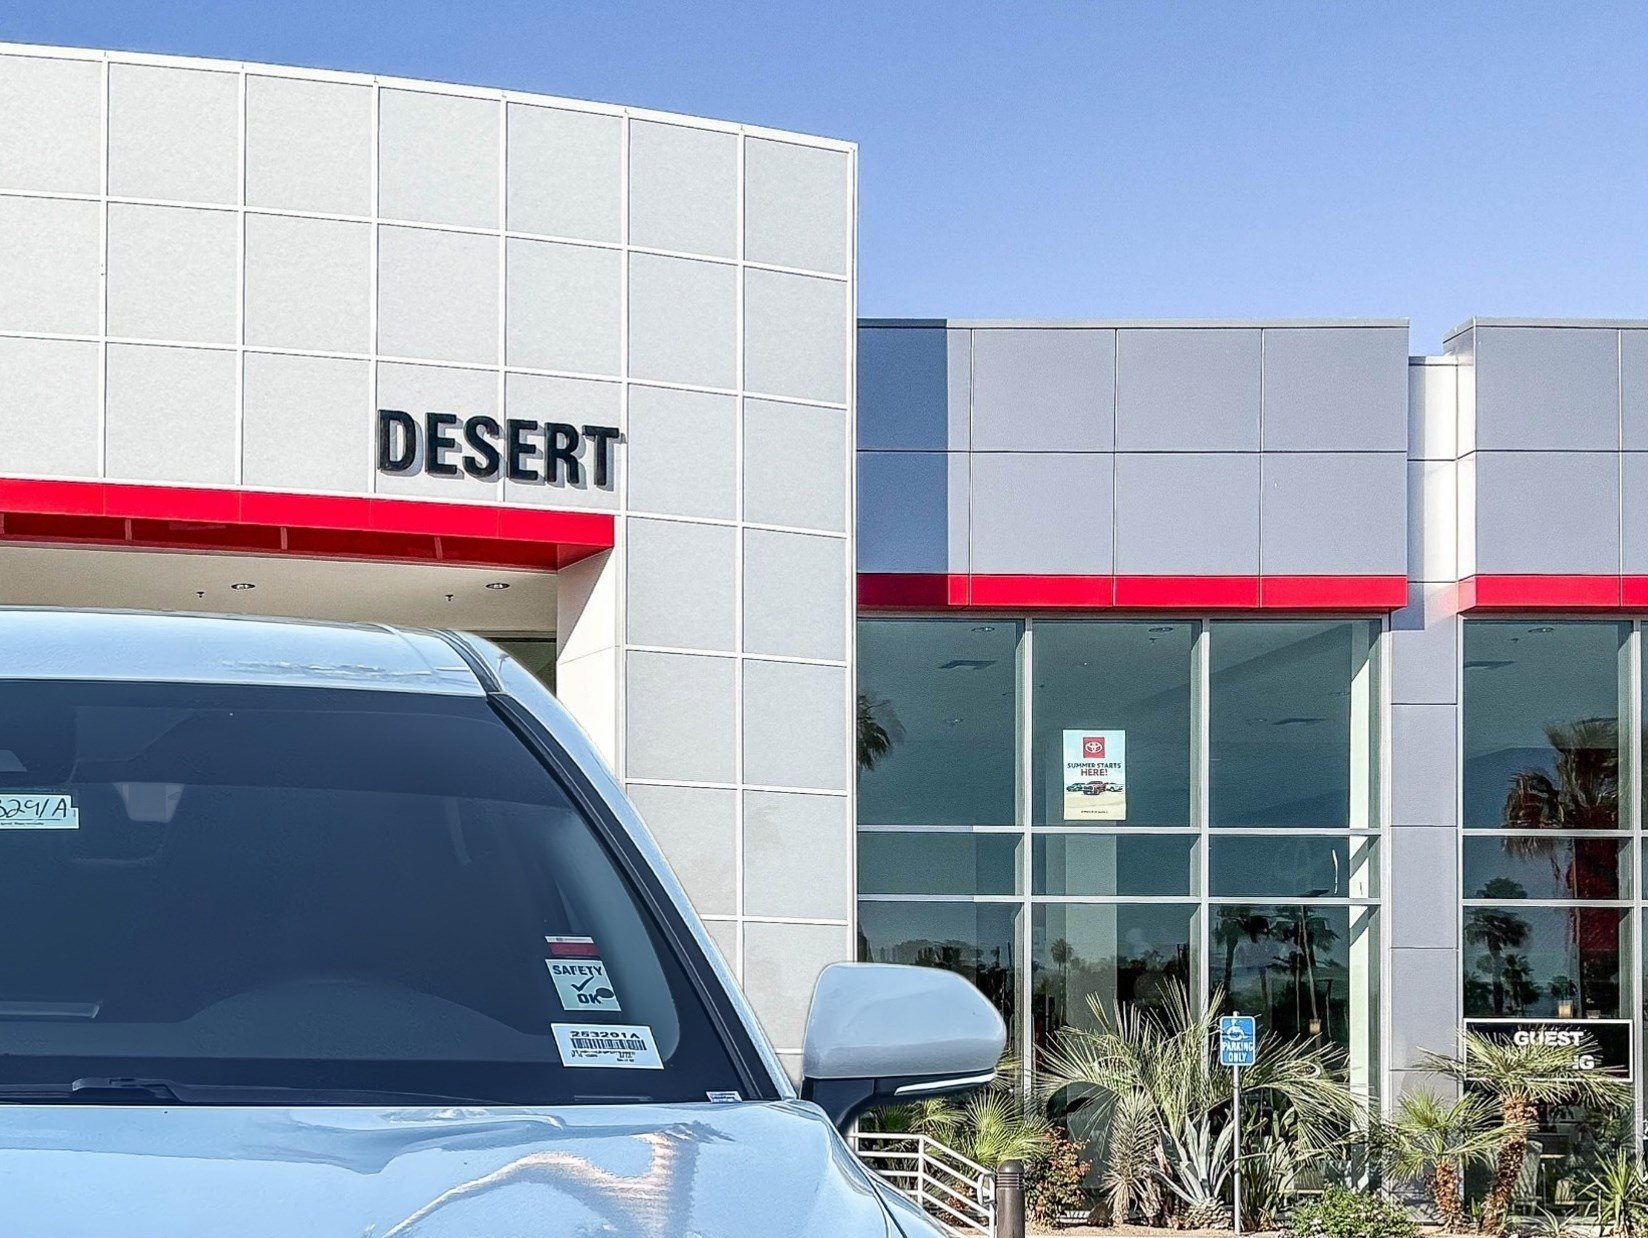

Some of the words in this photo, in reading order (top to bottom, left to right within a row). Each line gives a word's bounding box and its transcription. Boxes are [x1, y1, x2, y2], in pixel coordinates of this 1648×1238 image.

[377, 409, 620, 487] DESERT
[1081, 768, 1108, 776] HERE!
[551, 964, 604, 976] SAFETY
[576, 993, 602, 1005] OK
[1513, 1031, 1585, 1047] GUEST
[1223, 1041, 1254, 1052] PARKING
[1228, 1052, 1247, 1062] ONLY
